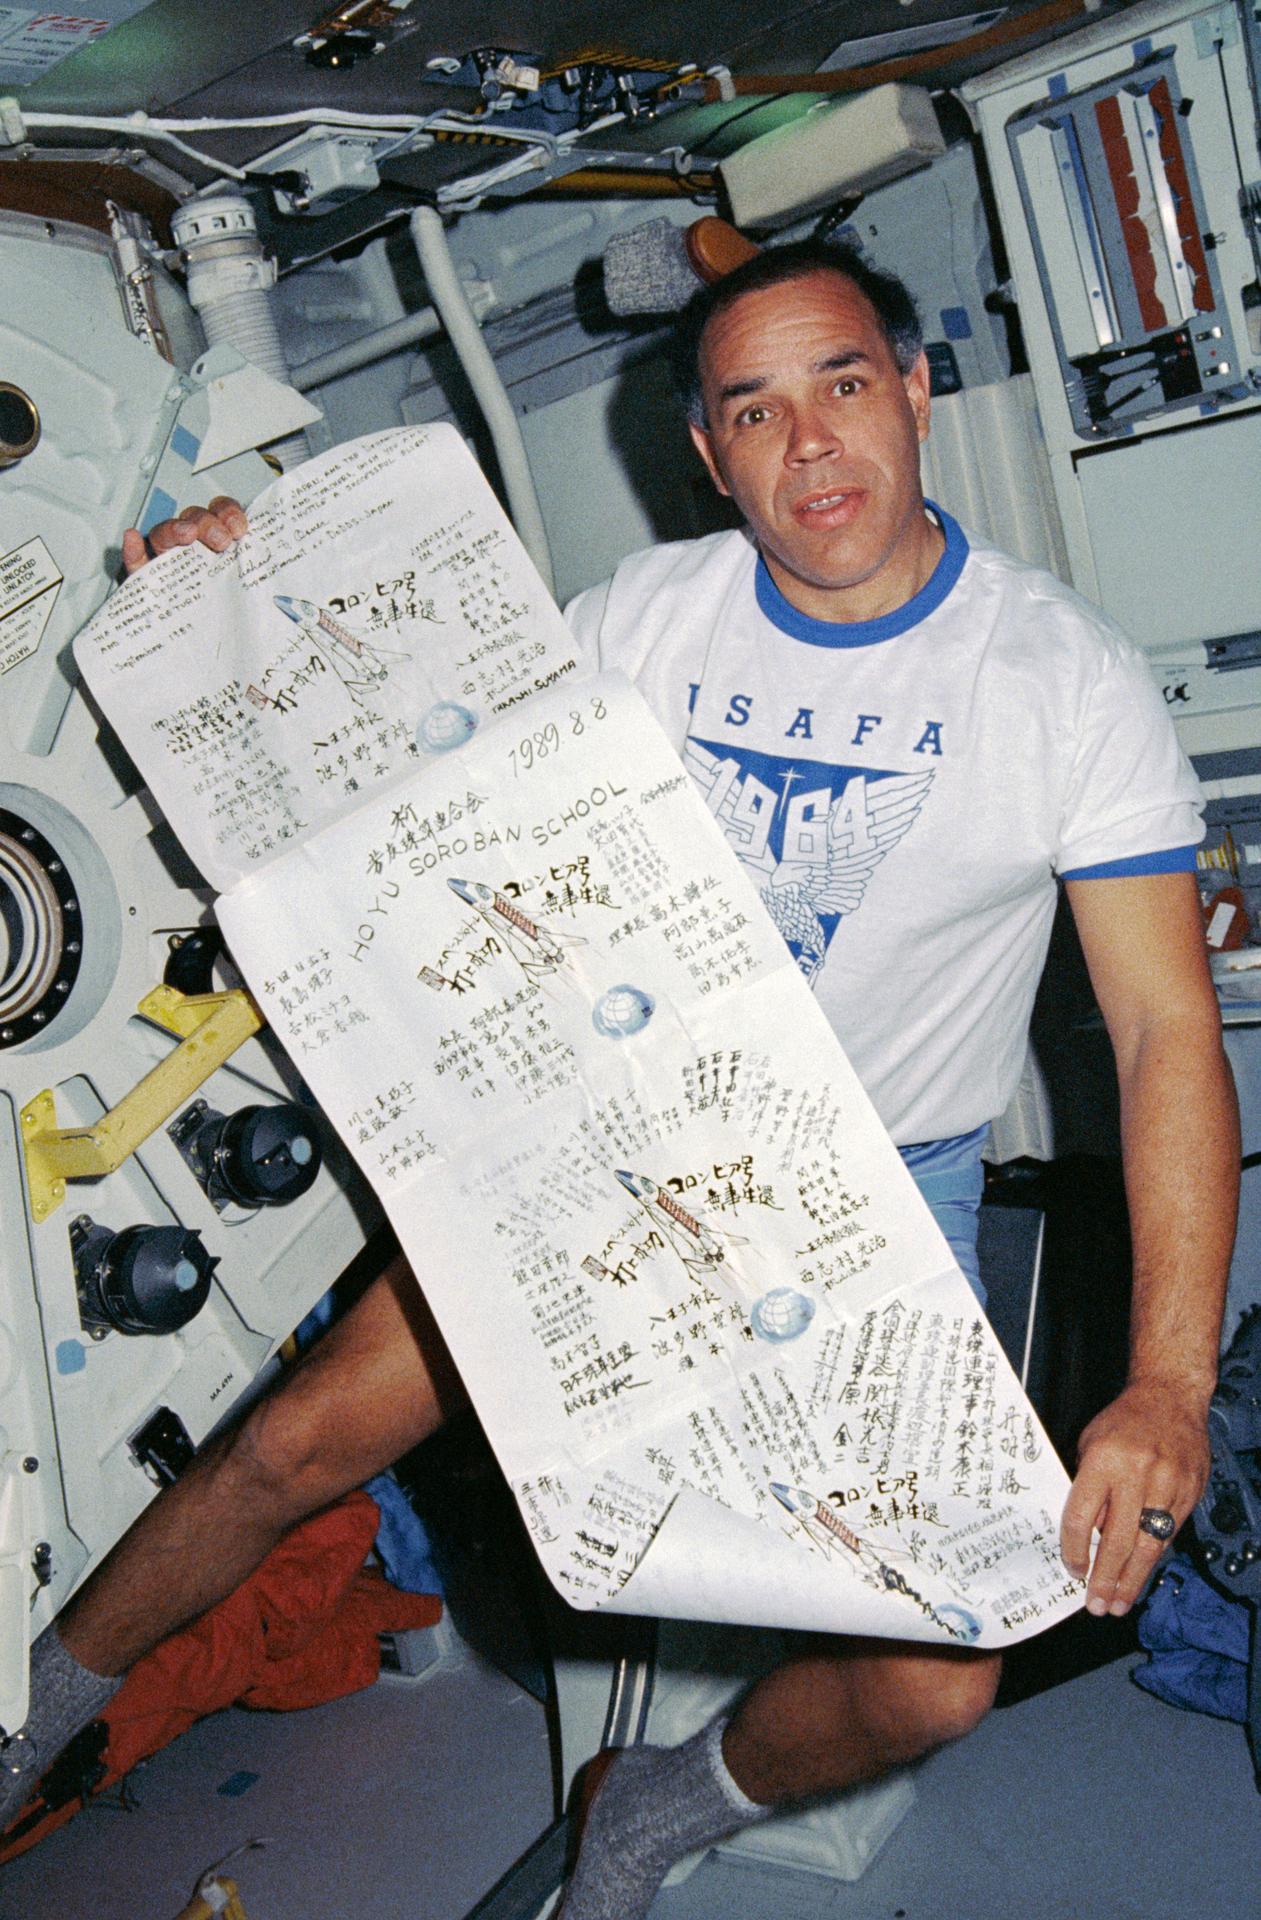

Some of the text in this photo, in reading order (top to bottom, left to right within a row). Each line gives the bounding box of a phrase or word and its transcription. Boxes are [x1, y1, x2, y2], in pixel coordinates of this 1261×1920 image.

[1, 558, 37, 585] UNLOCKED
[3, 571, 35, 595] UNLATCH
[6, 645, 29, 665] HATCH
[535, 660, 577, 691] SUYAMA
[409, 824, 522, 877] SOROBAN
[531, 780, 627, 846] SCHOOL
